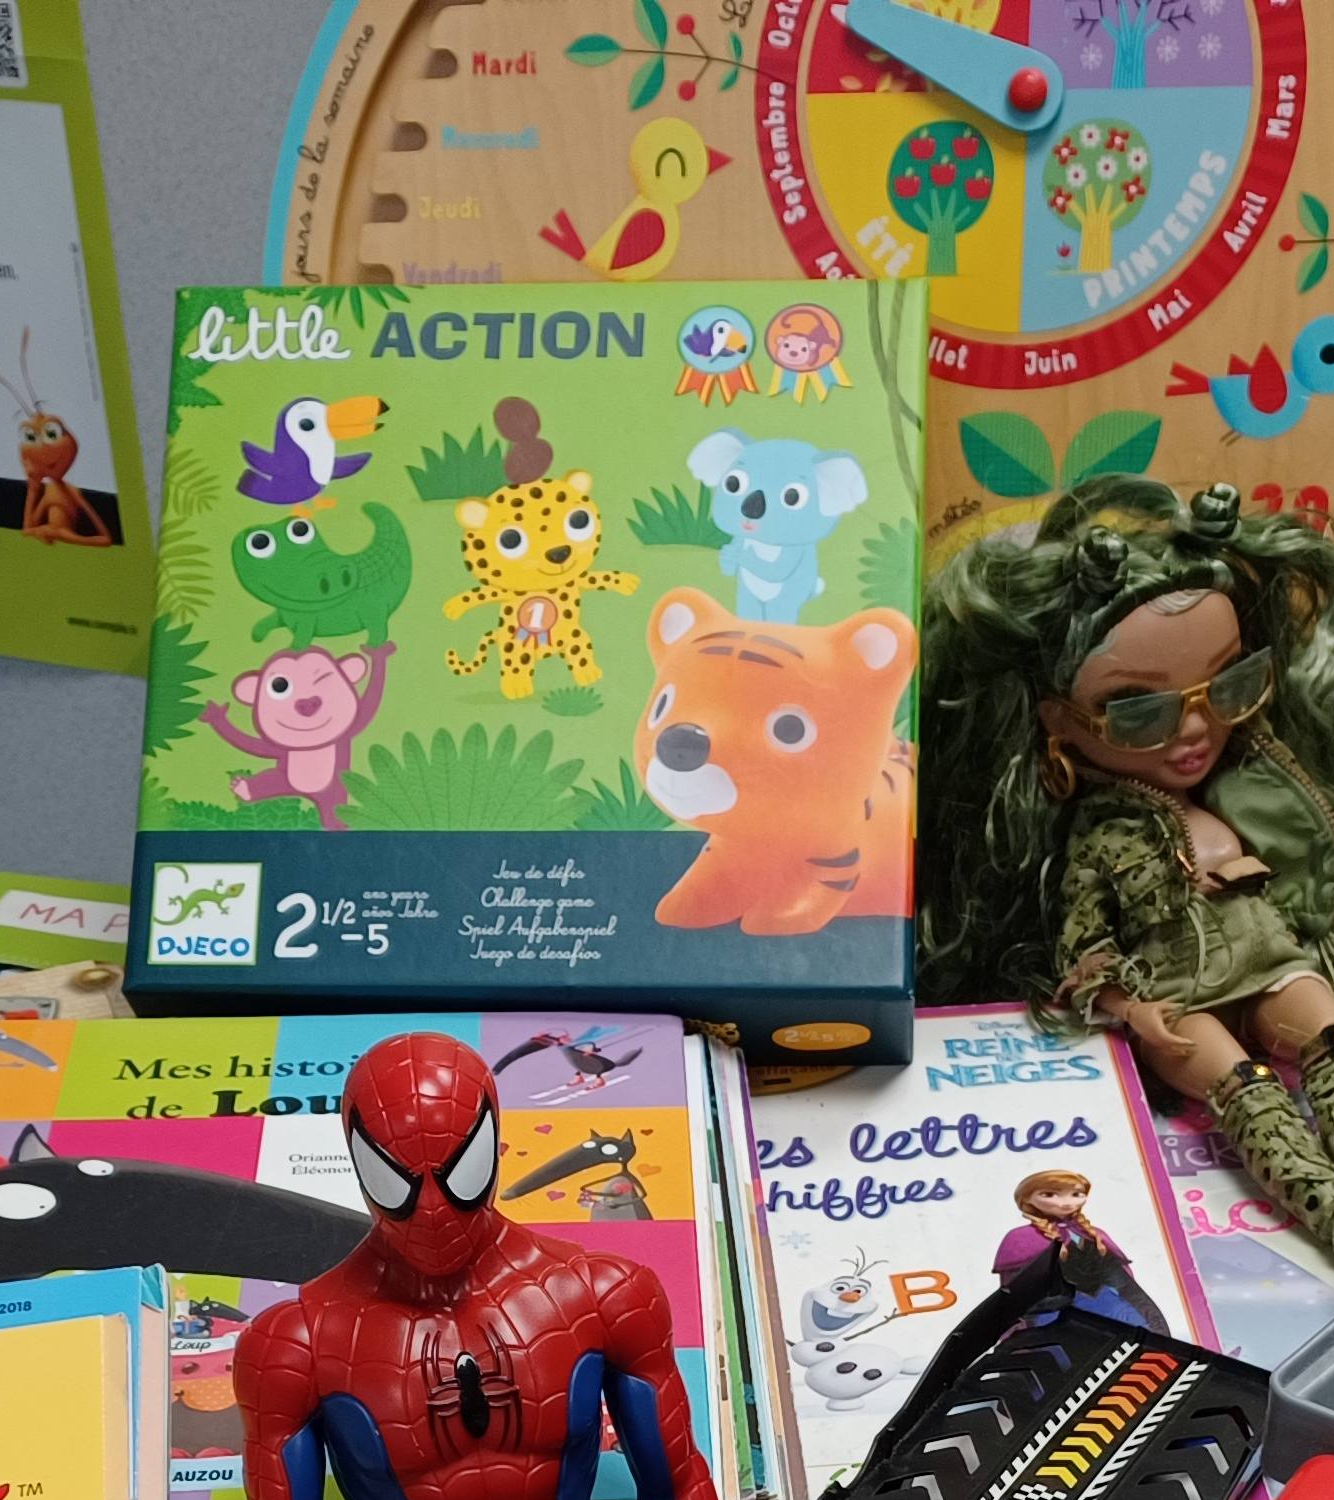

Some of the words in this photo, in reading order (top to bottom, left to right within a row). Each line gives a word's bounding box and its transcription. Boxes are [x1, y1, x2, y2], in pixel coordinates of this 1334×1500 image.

[472, 51, 538, 76] Mardi
[1266, 73, 1297, 140] Mars
[763, 81, 808, 224] Septembre
[418, 197, 483, 221] Jeudi
[1223, 191, 1267, 254] Avril
[1081, 148, 1227, 308] PRINTEMPS
[857, 215, 915, 277] ÉTÉ
[402, 261, 503, 284] Vendredi
[1147, 287, 1194, 332] Mai
[188, 303, 351, 363] little
[370, 312, 646, 360] ACTION
[1024, 346, 1078, 377] Juin
[524, 601, 547, 630] 1
[493, 859, 520, 882] Jeu
[525, 864, 544, 881] de
[547, 858, 585, 888] défis
[481, 887, 552, 911] Challenge
[557, 894, 596, 912] game
[19, 903, 86, 929] MA
[273, 892, 320, 959] 2
[321, 898, 357, 926] 1/2
[458, 915, 505, 943] Spiel
[508, 914, 618, 945] Aufgabenspiel
[157, 935, 250, 958] DJECO
[469, 940, 511, 967] Juego
[516, 944, 536, 961] de
[540, 940, 602, 967] desafíos
[943, 1031, 1071, 1060] REINE
[116, 1057, 213, 1081] Mes
[925, 1055, 1105, 1093] NEIGES
[127, 1094, 183, 1120] de
[209, 1090, 344, 1118] Lou
[849, 1112, 1099, 1164] lettres
[887, 1270, 959, 1317] B
[171, 1338, 212, 1352] Loup
[172, 1468, 234, 1484] AUZOU
